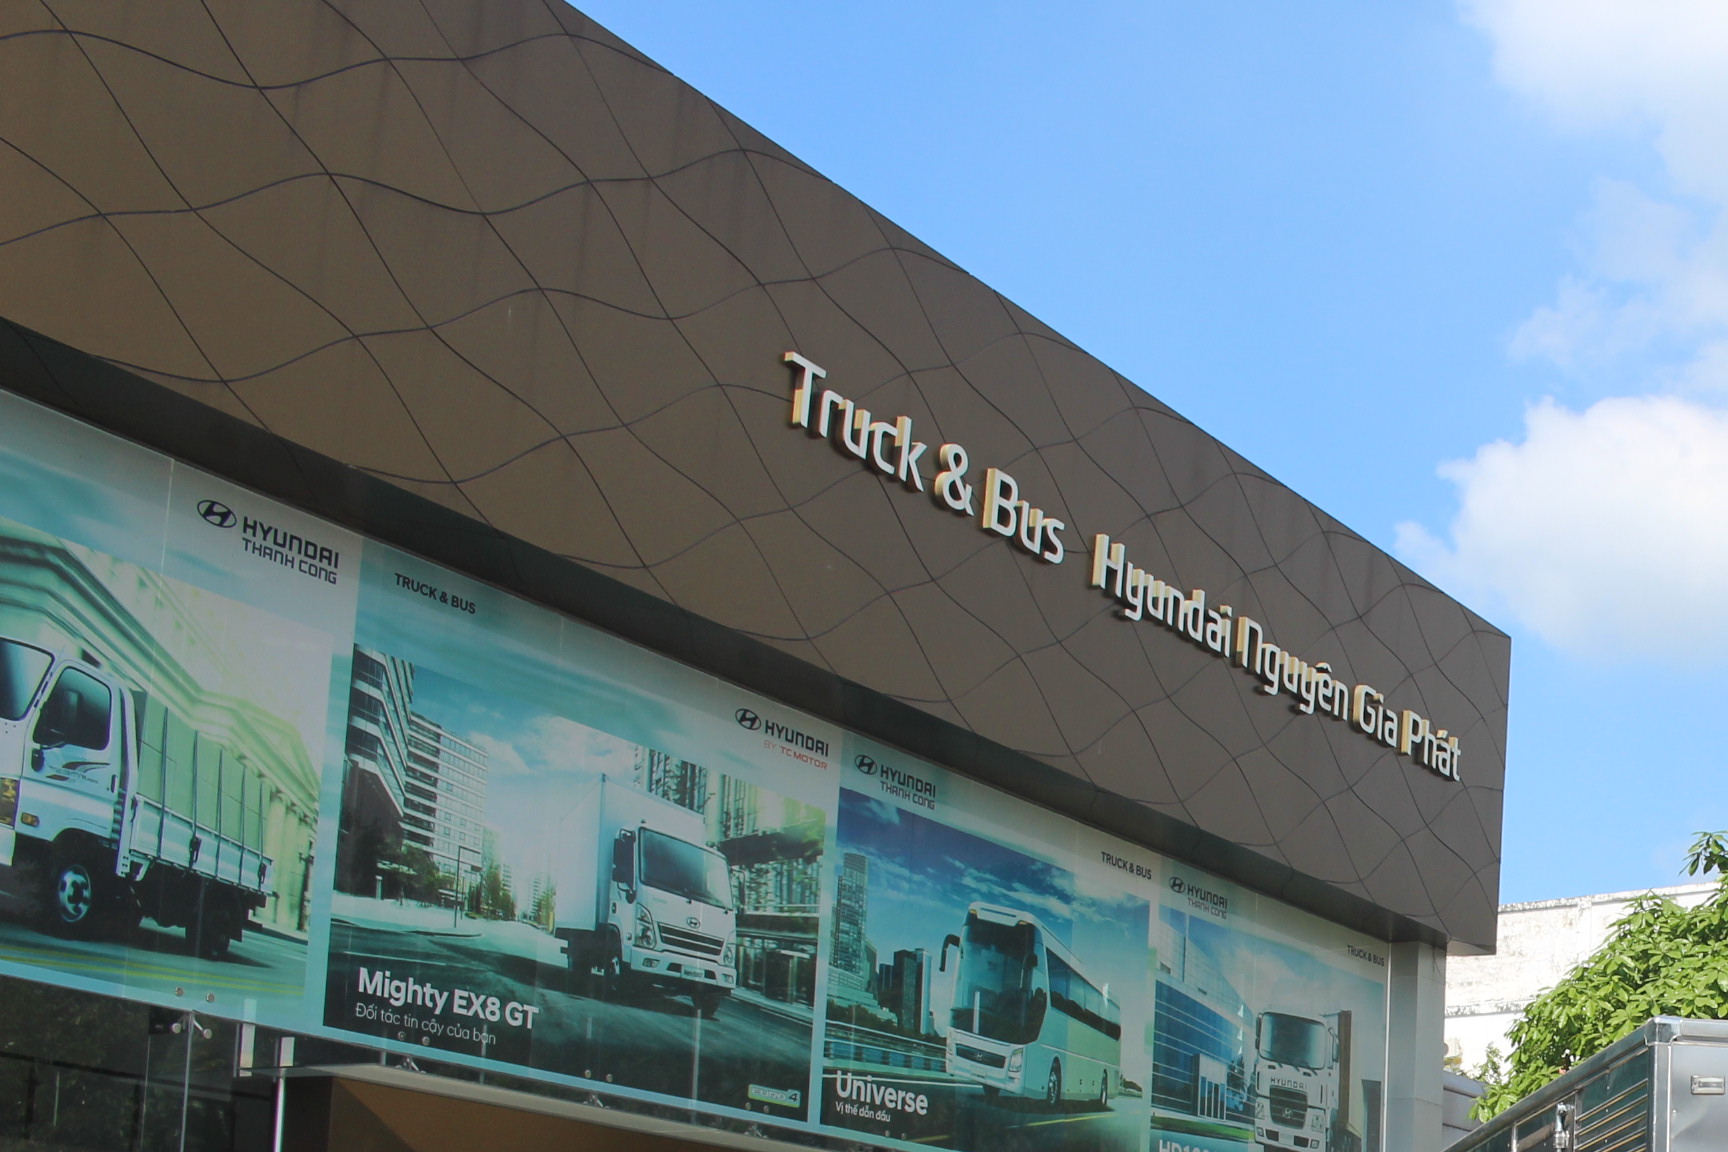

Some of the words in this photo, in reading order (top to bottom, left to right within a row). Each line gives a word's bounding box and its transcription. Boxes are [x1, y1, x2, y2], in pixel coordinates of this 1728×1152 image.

[242, 515, 340, 569] HYUNDAI
[241, 537, 295, 569] THANH
[298, 559, 337, 585] CONG
[784, 351, 927, 492] Truck
[934, 443, 975, 517] &
[982, 467, 1065, 564] Bus
[1092, 533, 1232, 658] Hyundai
[1353, 684, 1398, 748] Gia
[1401, 710, 1461, 782] Phát
[394, 572, 438, 600] TRUCK
[438, 591, 448, 605] &
[451, 594, 477, 614] BUS
[763, 739, 777, 751] BY
[780, 745, 792, 758] TC
[792, 752, 828, 771] MOTOR
[764, 719, 830, 758] HYUNDAI
[879, 764, 937, 798] HYUNDAI
[879, 780, 911, 801] THANH
[912, 793, 936, 811] CONG
[1101, 851, 1128, 872] TRUCK
[1128, 862, 1135, 874] &
[1135, 864, 1152, 880] BUS
[1187, 884, 1228, 910] HYUNDAI
[1187, 897, 1210, 914] THANH
[357, 966, 450, 1015] Mighty
[453, 988, 501, 1022] EX8
[504, 1001, 540, 1029] GT
[355, 1002, 378, 1020] Đối
[380, 1009, 401, 1025] tác
[403, 1013, 419, 1029] tin
[421, 1017, 445, 1036] cậy
[446, 1023, 470, 1039] của
[788, 1092, 798, 1102] 4
[836, 1070, 929, 1116] Universe
